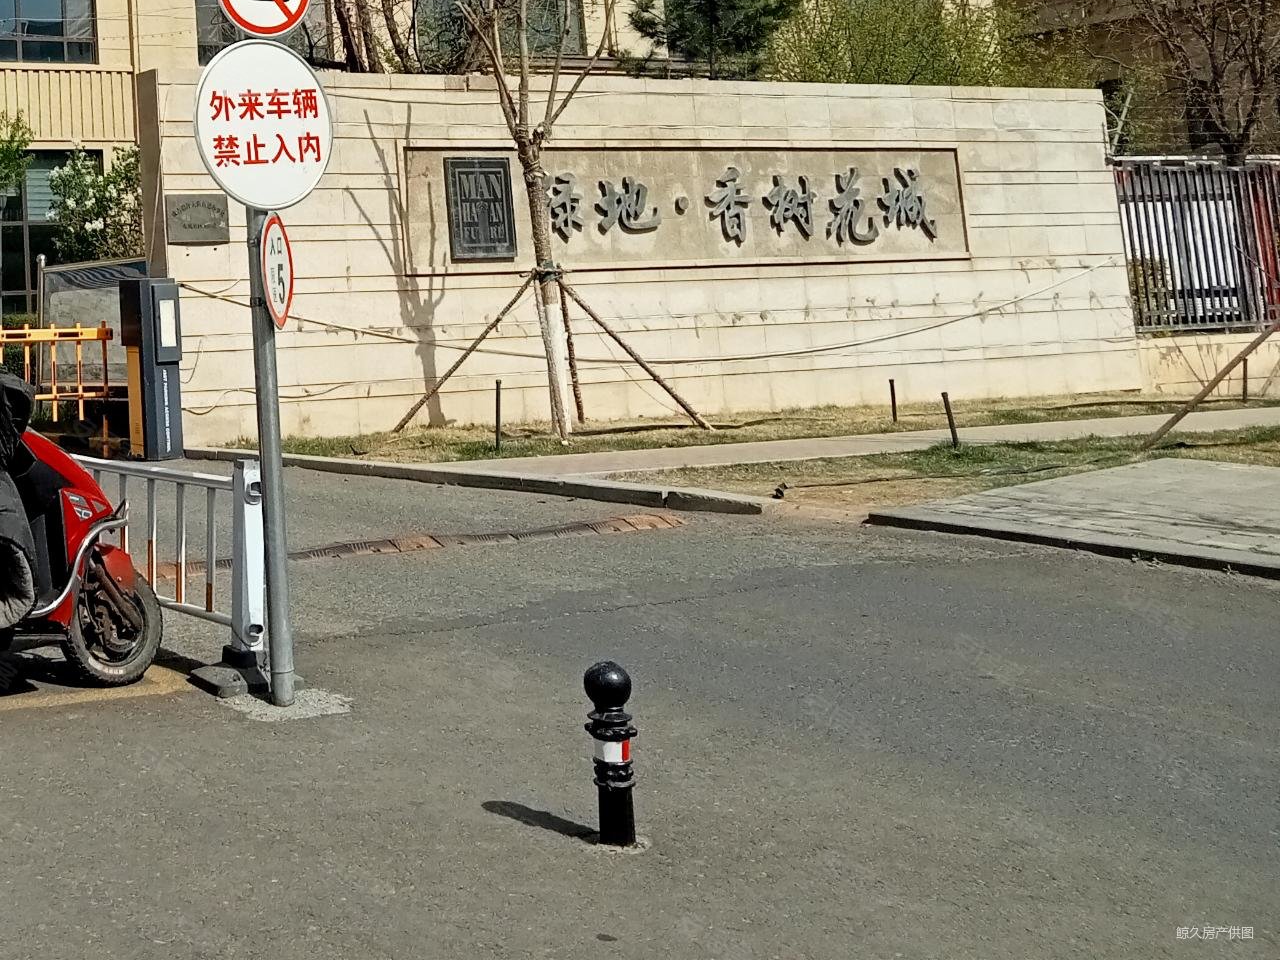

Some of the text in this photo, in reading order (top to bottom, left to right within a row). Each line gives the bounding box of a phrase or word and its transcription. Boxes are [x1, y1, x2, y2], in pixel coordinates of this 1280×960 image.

[209, 88, 319, 122] 外来车辆
[212, 131, 321, 168] 禁止入内
[459, 174, 502, 200] MAN
[277, 263, 286, 305] 5
